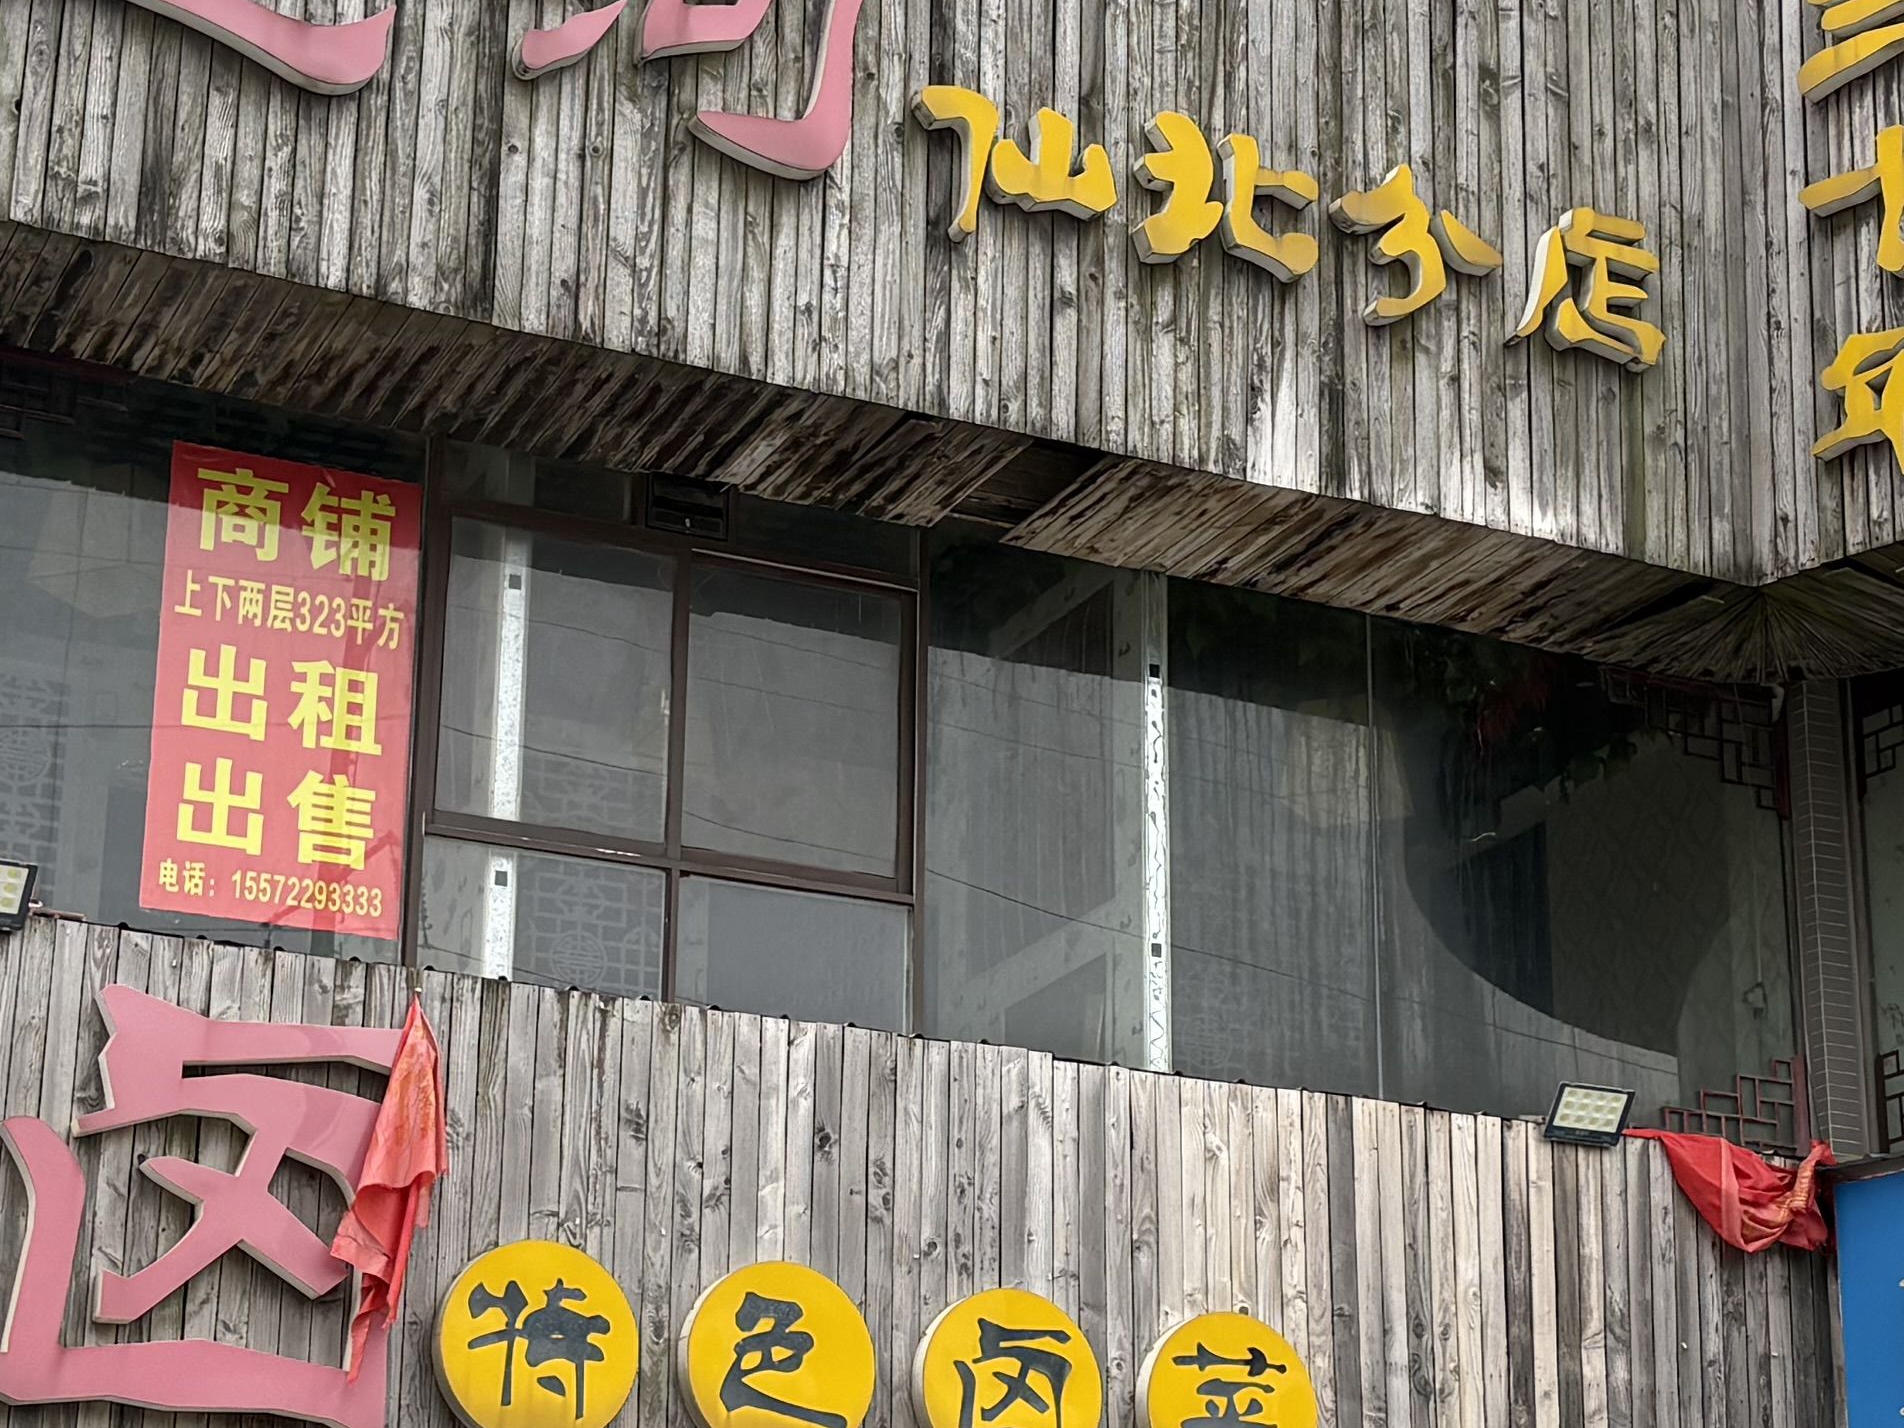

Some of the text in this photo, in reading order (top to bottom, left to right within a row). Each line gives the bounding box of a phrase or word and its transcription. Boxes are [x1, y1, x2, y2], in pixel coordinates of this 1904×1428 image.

[197, 468, 396, 581] 商铺
[175, 569, 405, 650] 上下两层323平方
[181, 644, 383, 756] 出租
[176, 758, 377, 870] 出售
[231, 869, 384, 918] 15572293333
